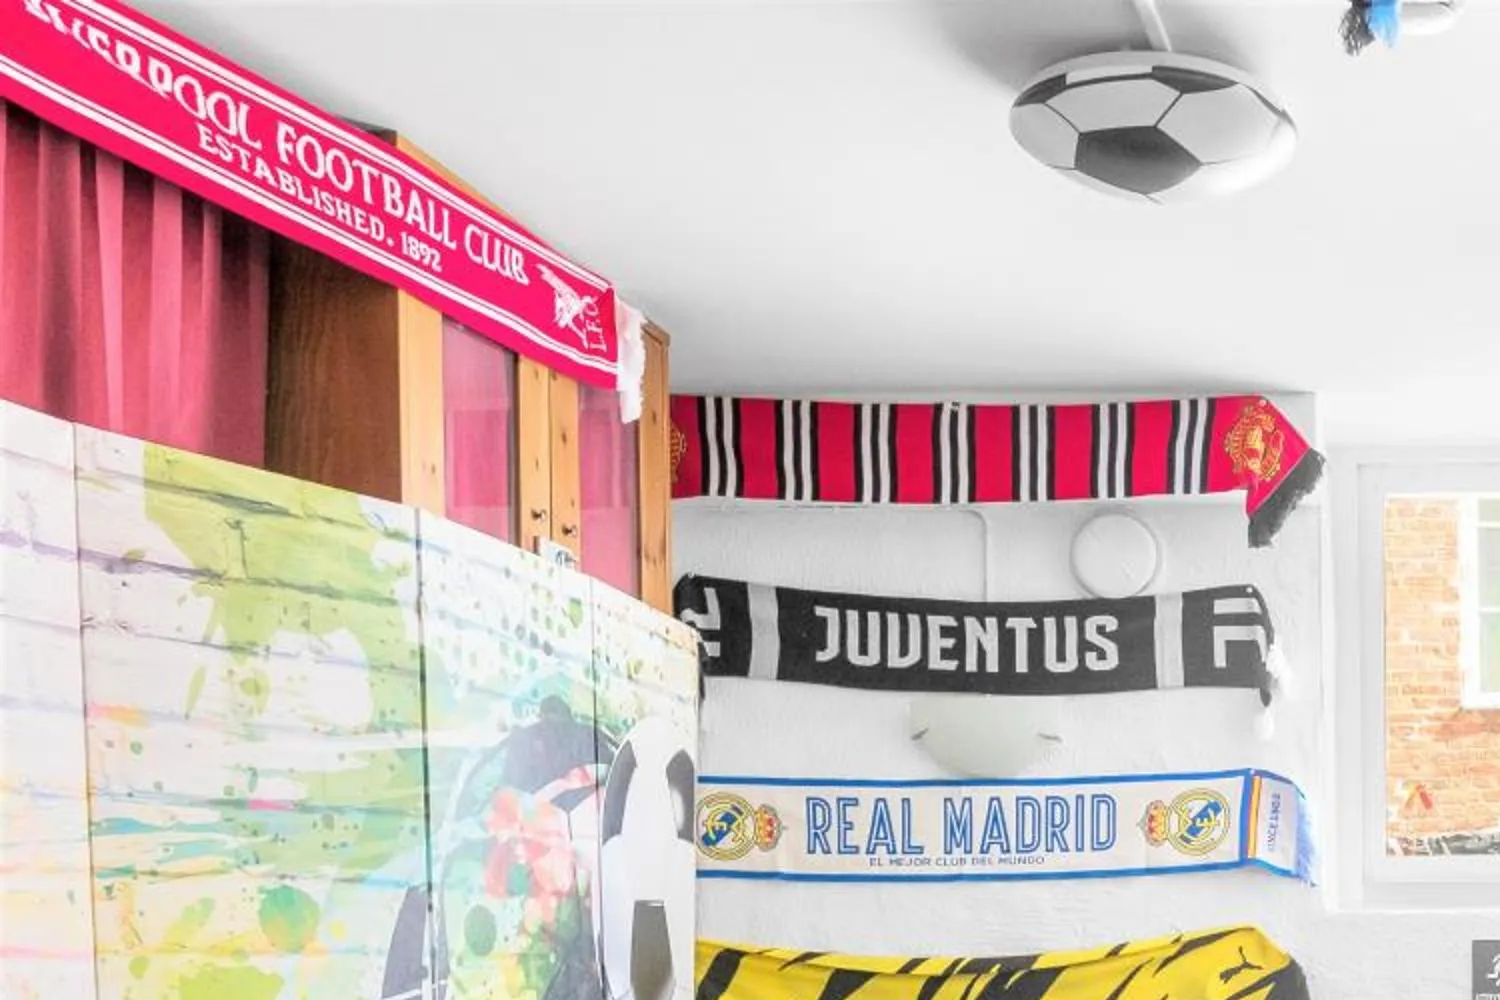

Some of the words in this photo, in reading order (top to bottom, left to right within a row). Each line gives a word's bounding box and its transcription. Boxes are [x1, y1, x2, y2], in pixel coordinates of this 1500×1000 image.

[25, 0, 262, 149] ERPOOL
[278, 123, 456, 250] FOOTBALL
[464, 228, 530, 287] CLUB
[400, 231, 442, 272] 1892
[813, 605, 1120, 674] JUVENTUS
[805, 796, 925, 855] REAL
[943, 793, 1117, 855] MADRID
[869, 857, 883, 868] EL
[889, 857, 931, 867] MEJOR
[935, 857, 967, 867] CLUB
[971, 856, 993, 867] DEL
[998, 855, 1045, 866] MUNDO
